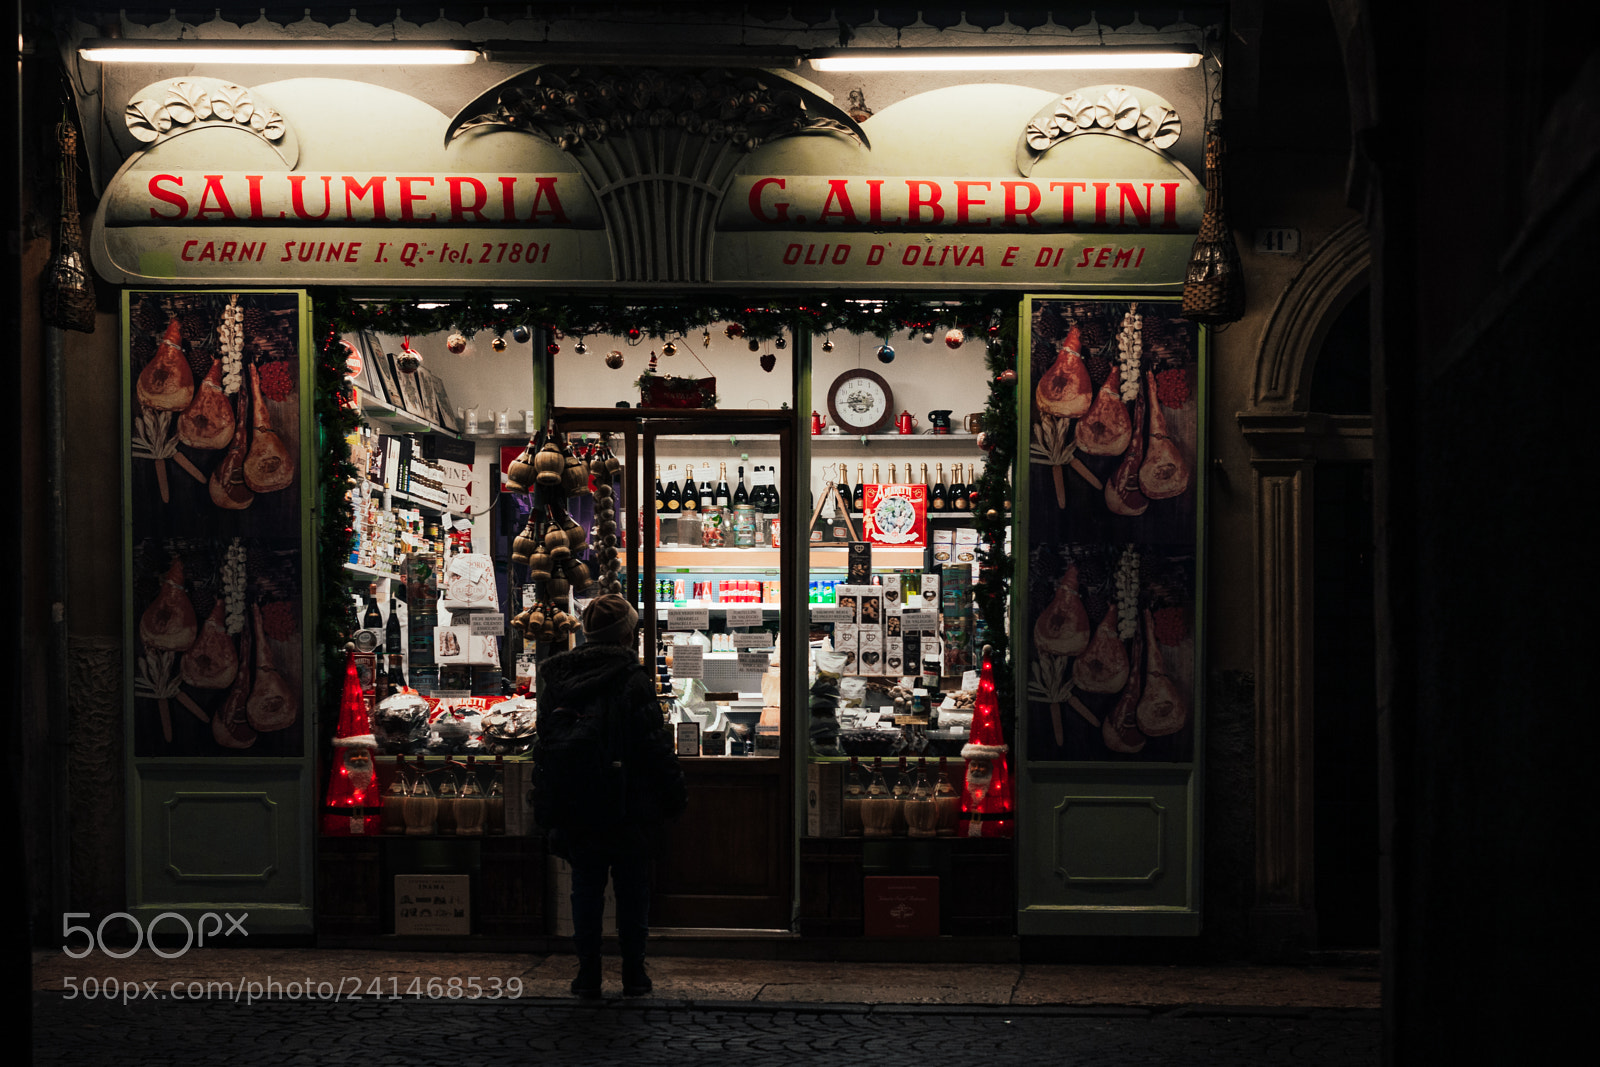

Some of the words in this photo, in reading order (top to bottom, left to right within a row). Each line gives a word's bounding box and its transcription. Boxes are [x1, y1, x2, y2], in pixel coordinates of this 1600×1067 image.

[148, 174, 572, 224] SALUMERIA
[815, 179, 1180, 229] ALBERTINI
[181, 240, 267, 262] CARNI
[280, 241, 362, 263] SUINE
[479, 243, 551, 264] 27801
[782, 243, 851, 265] OLIO
[902, 245, 985, 267] OLIVA
[1001, 246, 1020, 267] E
[1034, 247, 1064, 267] DI
[1077, 247, 1146, 268] SEMI
